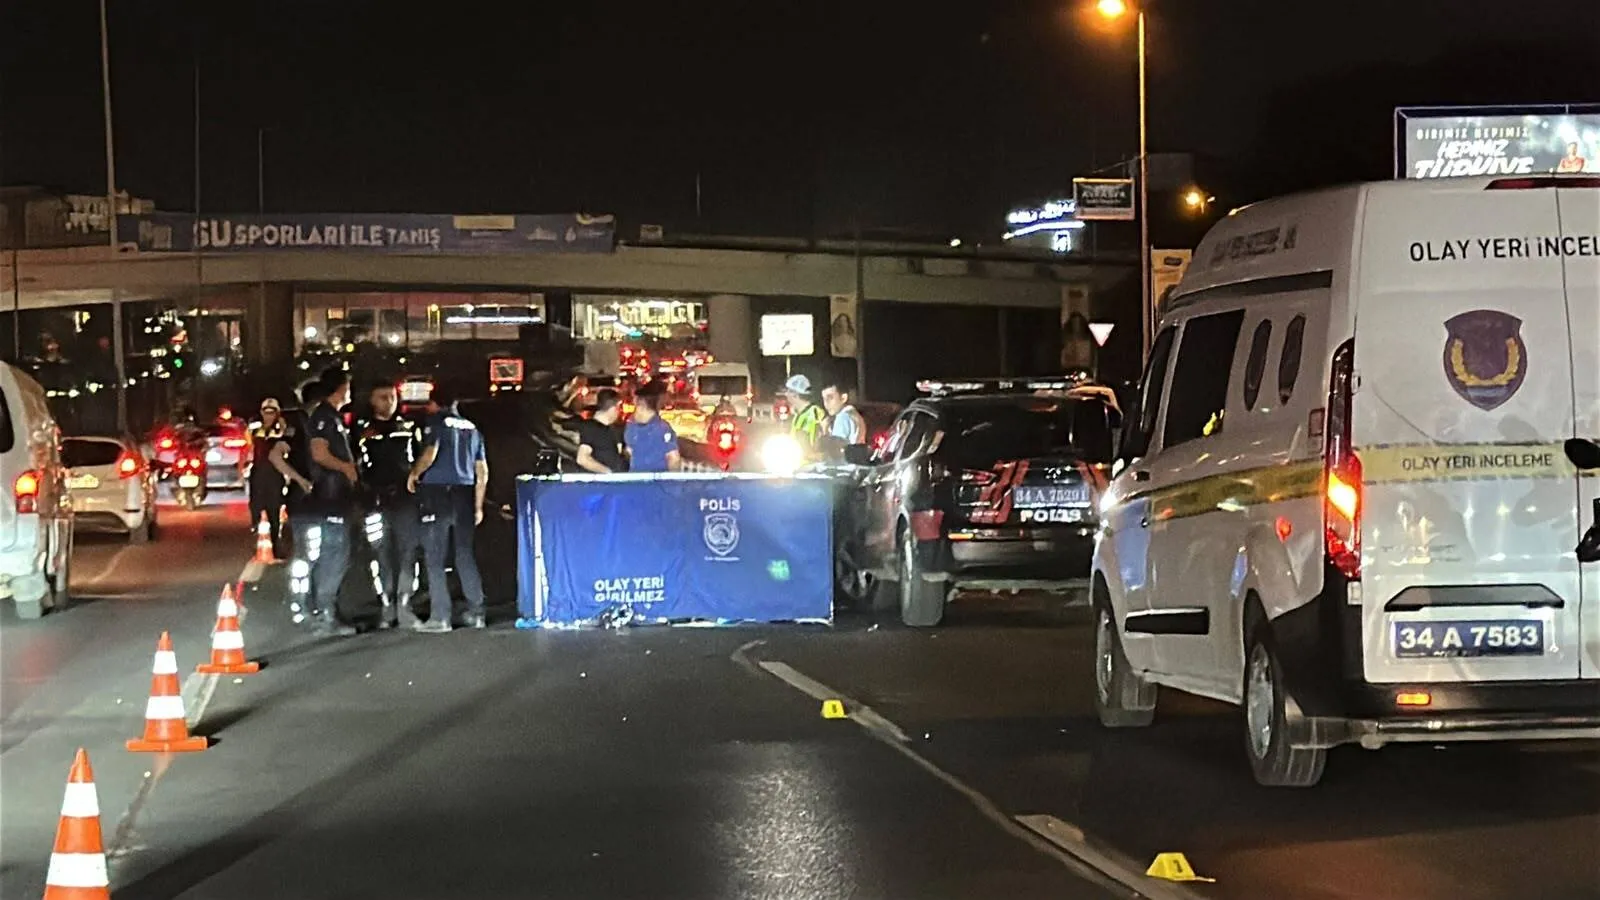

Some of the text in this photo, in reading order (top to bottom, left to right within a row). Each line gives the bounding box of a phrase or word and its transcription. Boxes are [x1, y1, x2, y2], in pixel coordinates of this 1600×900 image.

[194, 220, 231, 247] SU
[235, 223, 346, 247] SPORLARI
[386, 226, 441, 249] TANIŞ
[1409, 240, 1470, 262] OLAY
[1477, 237, 1530, 259] YERİ
[1402, 453, 1553, 471] OLAY YERİ İNCELEME
[1035, 489, 1046, 502] A
[594, 577, 630, 592] OLAY
[1400, 625, 1538, 649] 34 A 7583
